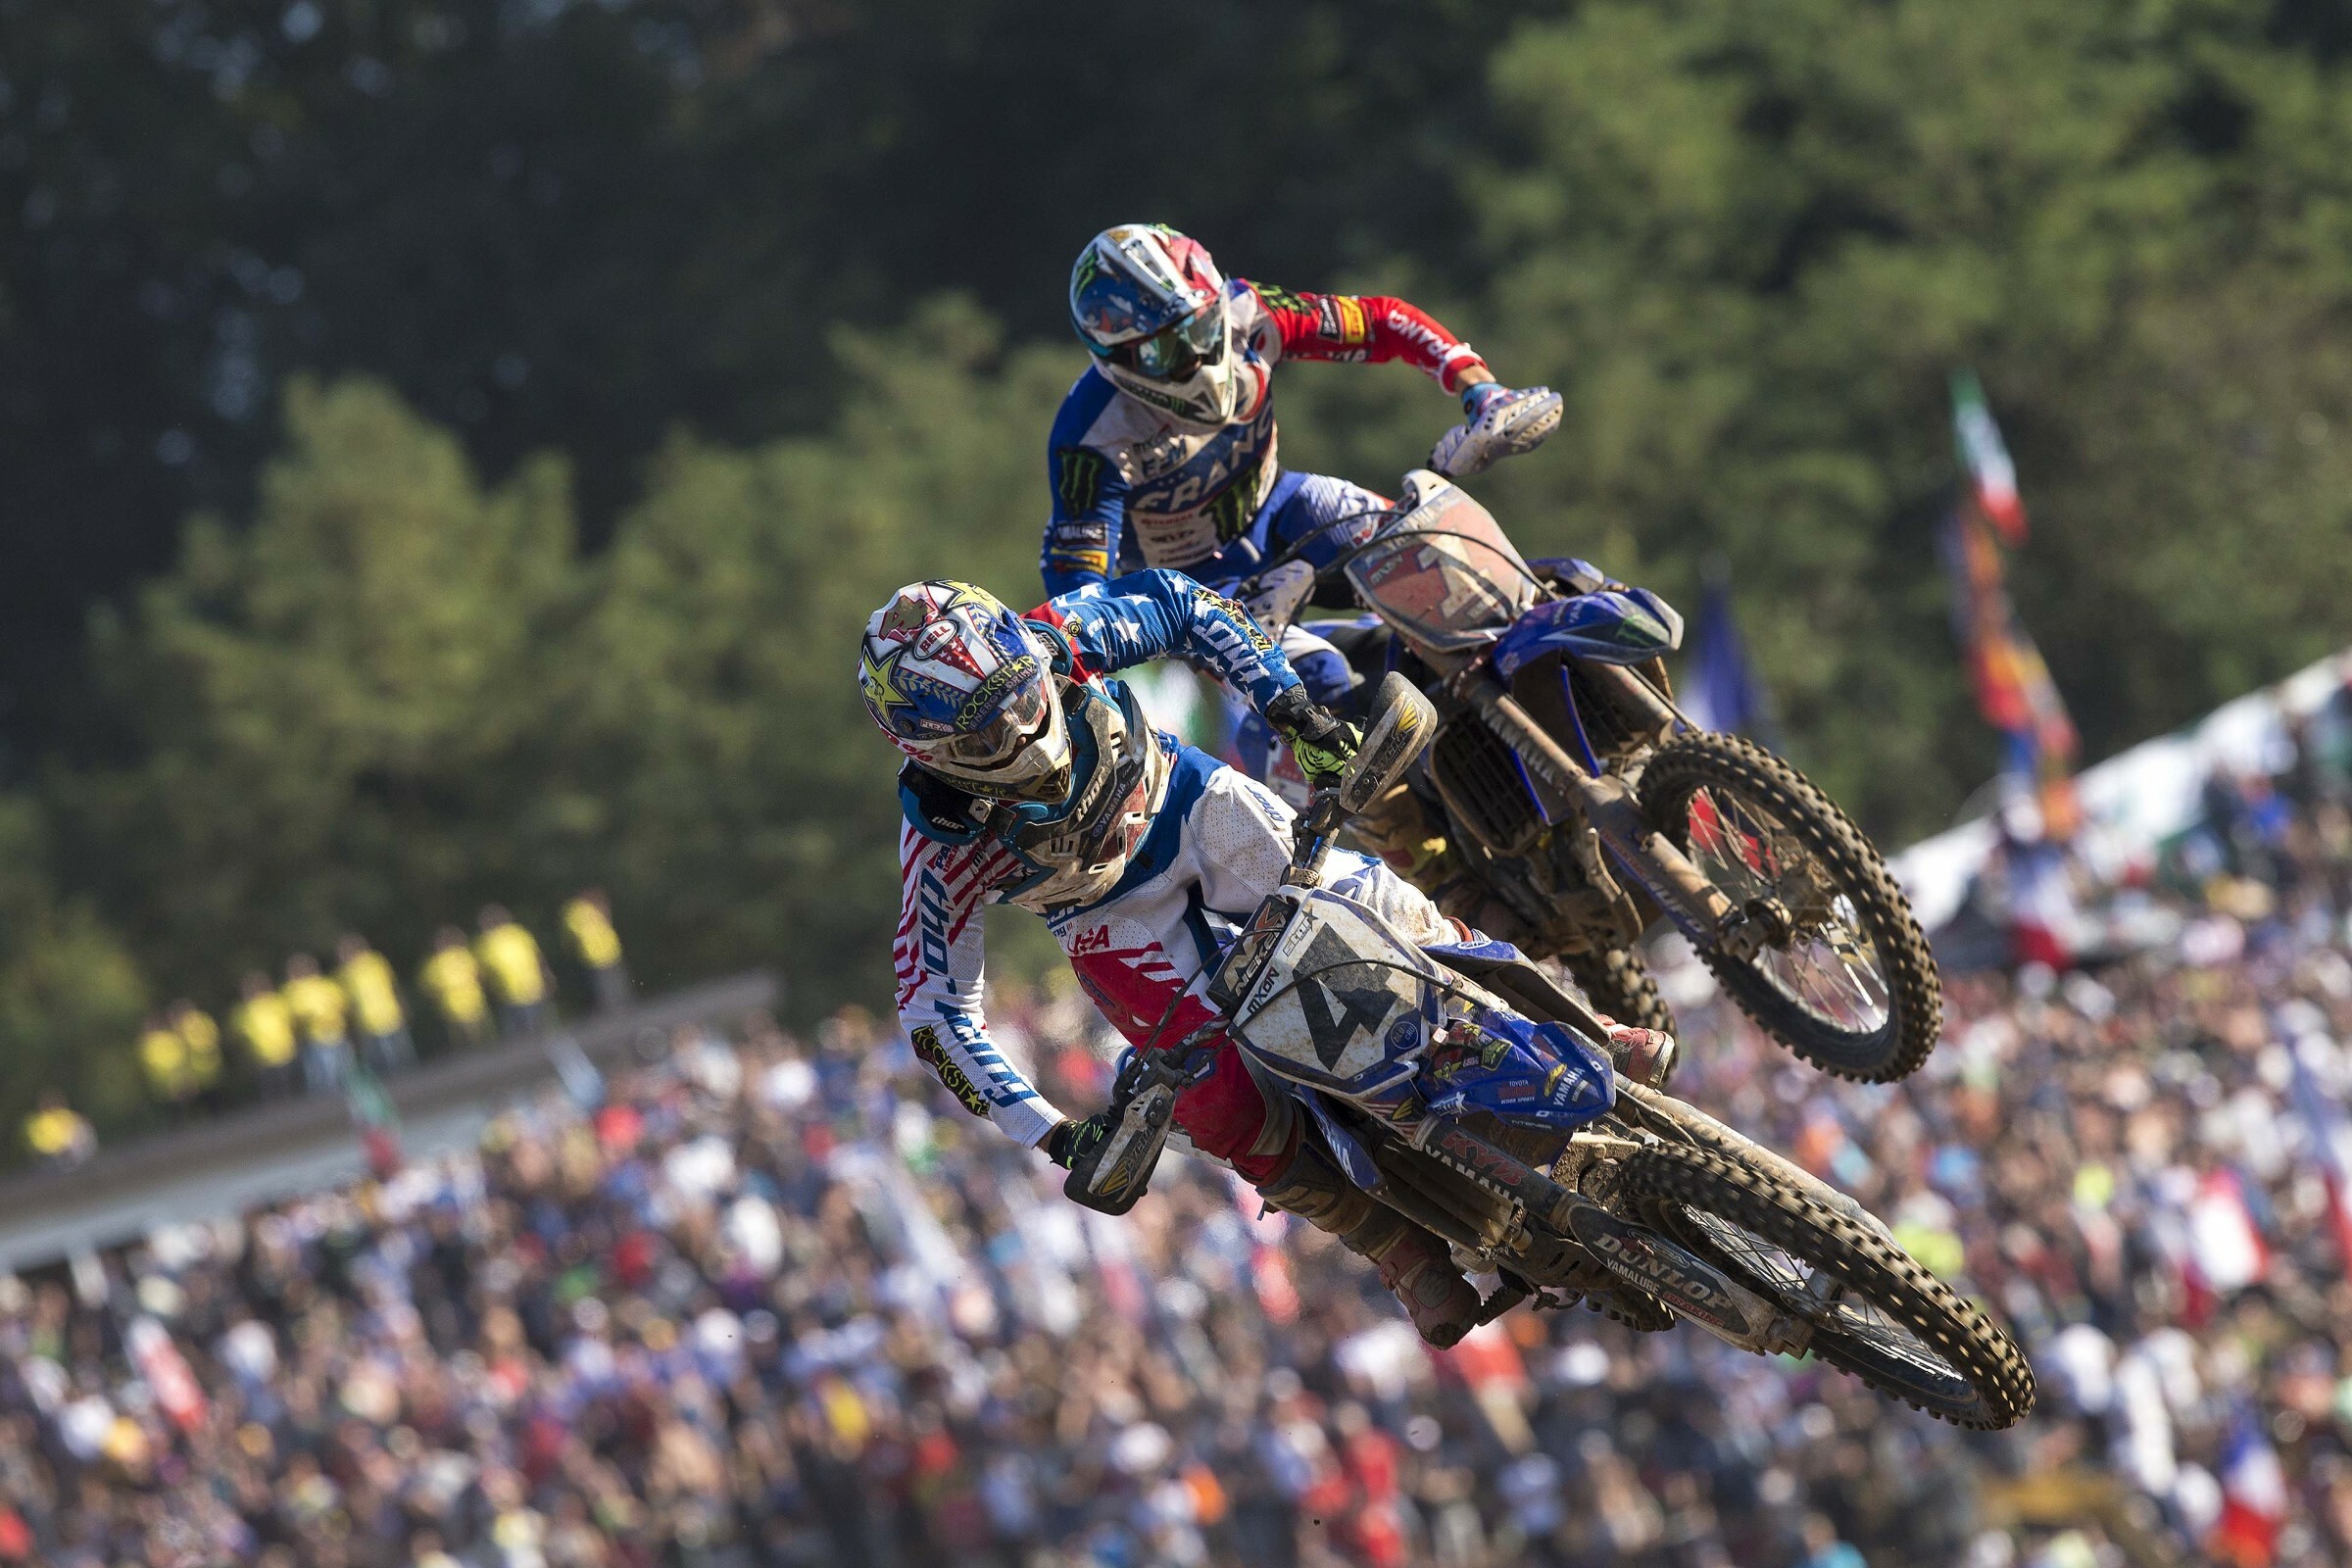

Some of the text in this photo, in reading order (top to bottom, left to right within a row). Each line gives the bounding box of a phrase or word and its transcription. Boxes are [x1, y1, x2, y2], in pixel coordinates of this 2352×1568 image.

[919, 625, 952, 654] BELL
[969, 665, 1037, 731] ENERGY DRINK
[1076, 766, 1105, 822] thor
[1101, 782, 1127, 826] YAMAHA
[932, 815, 965, 831] thor
[1292, 921, 1400, 1073] 4
[1553, 1065, 1587, 1107] YAMAHA
[1441, 1130, 1528, 1186] KYB
[1593, 1232, 1734, 1309] DUNLOP
[1606, 1257, 1661, 1296] YAMALUBE
